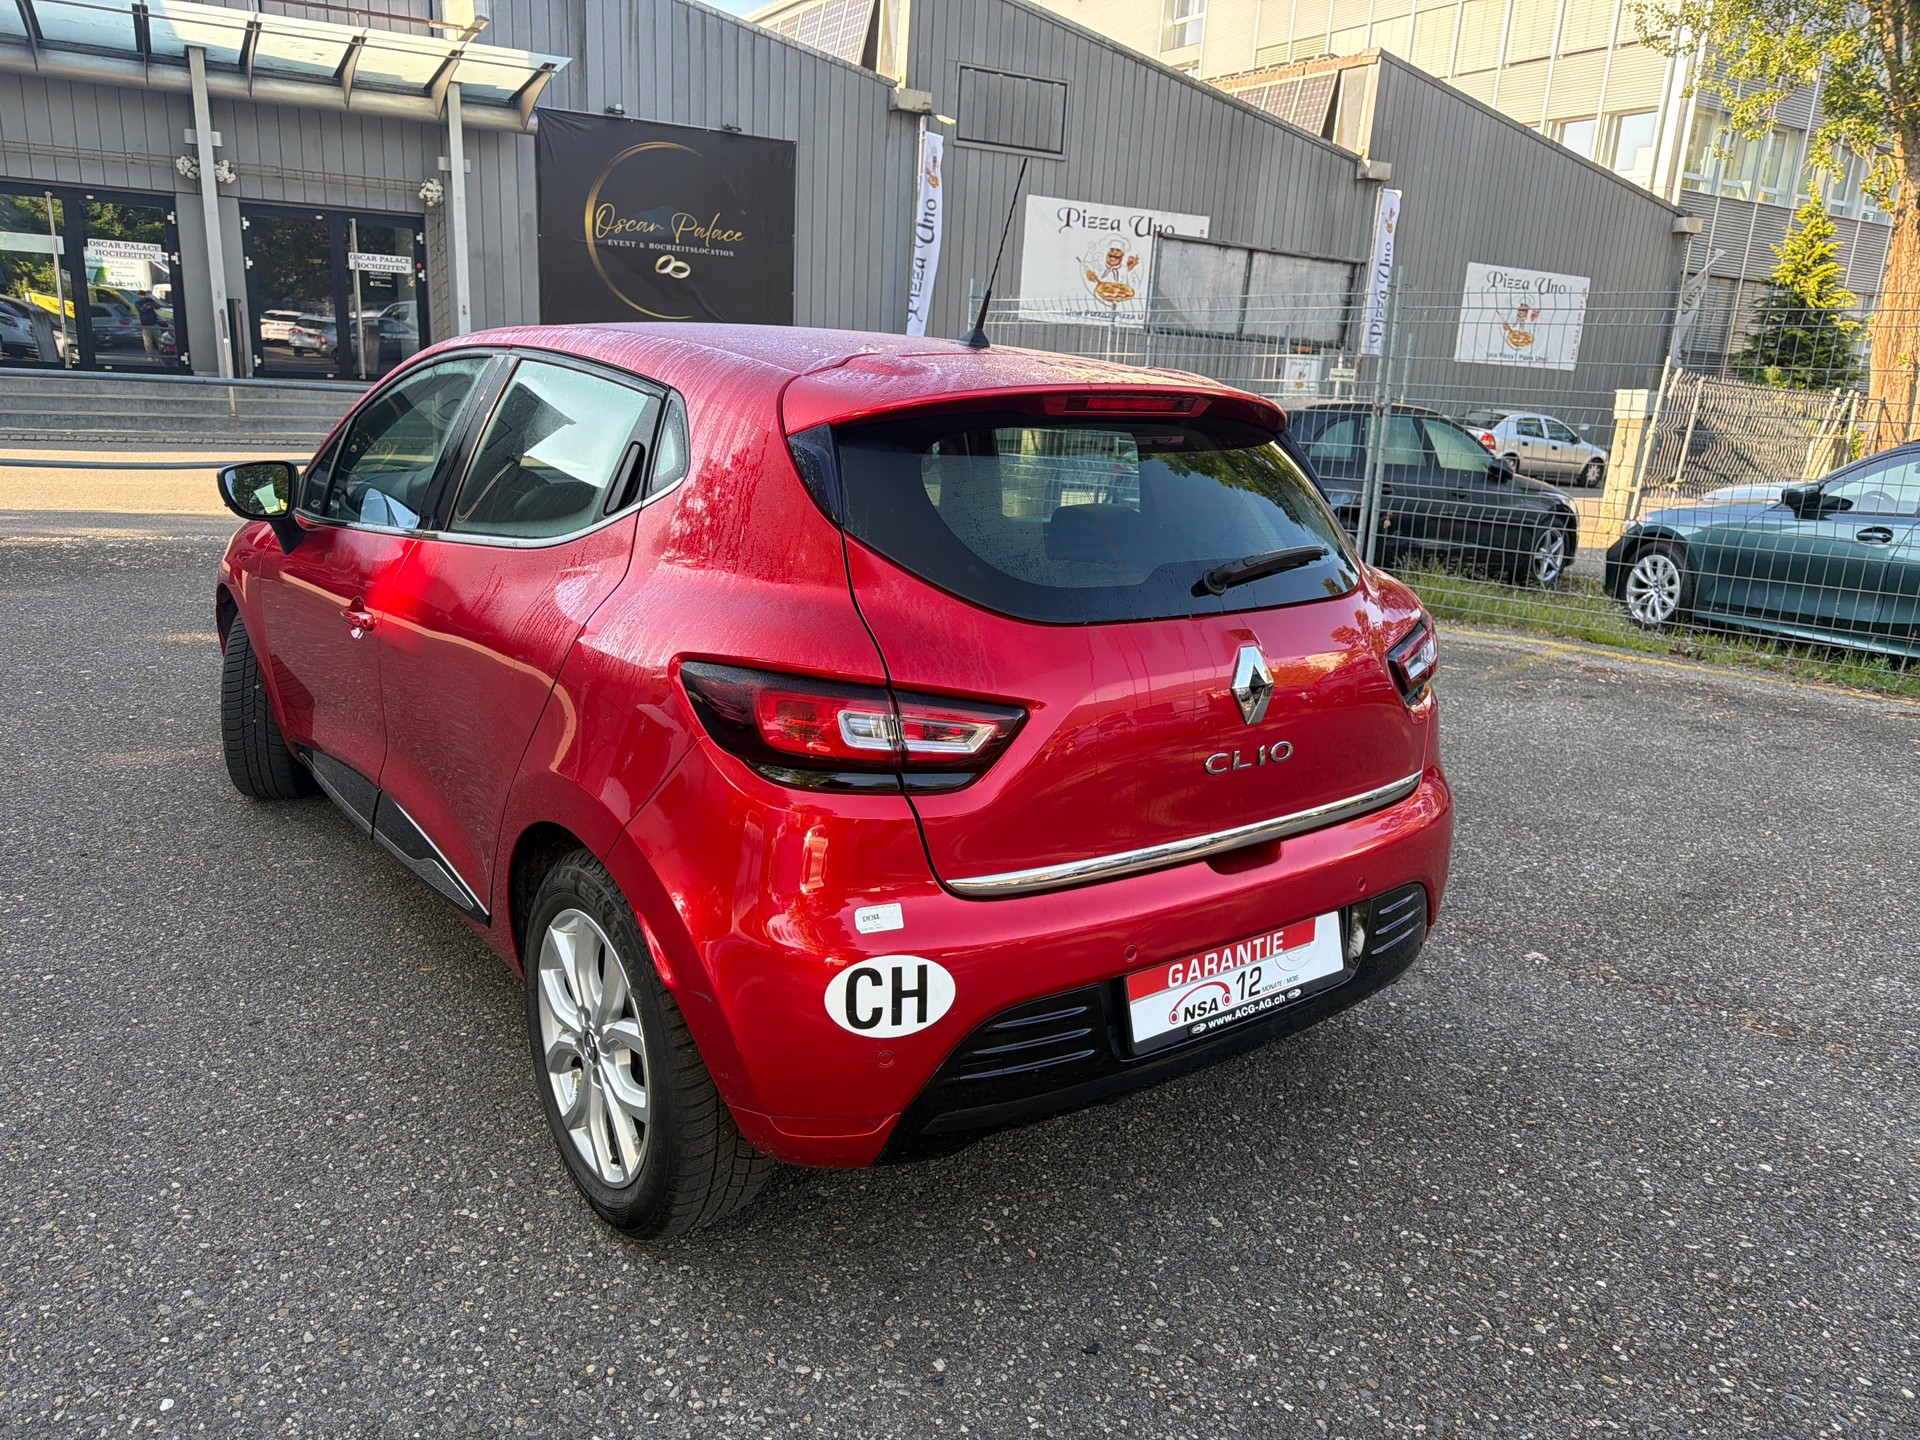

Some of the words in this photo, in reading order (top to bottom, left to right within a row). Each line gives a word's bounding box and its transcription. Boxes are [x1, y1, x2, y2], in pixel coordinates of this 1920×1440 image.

[596, 203, 664, 239] Oscar
[671, 212, 745, 247] Palace
[915, 198, 937, 248] Uno
[1057, 206, 1121, 234] Pizza
[89, 239, 121, 250] OSCAR
[124, 242, 160, 252] PALACE
[95, 249, 156, 260] HOCHZEITEN
[380, 256, 411, 264] PALACE
[608, 239, 636, 248] EVENT
[640, 241, 646, 249] &
[648, 242, 735, 257] HOCHZEITSLOCATION
[1486, 271, 1530, 293] Pizza
[1535, 277, 1566, 295] Uno
[1205, 741, 1293, 775] CLIO
[1168, 931, 1283, 988] GARANTIE
[846, 964, 927, 1030] CH
[1236, 966, 1262, 1001] 12
[1261, 980, 1283, 994] MONATE
[1286, 974, 1300, 984] MOIS
[1183, 997, 1219, 1023] NSA
[1207, 994, 1286, 1029] www.ACG-AG.ch
